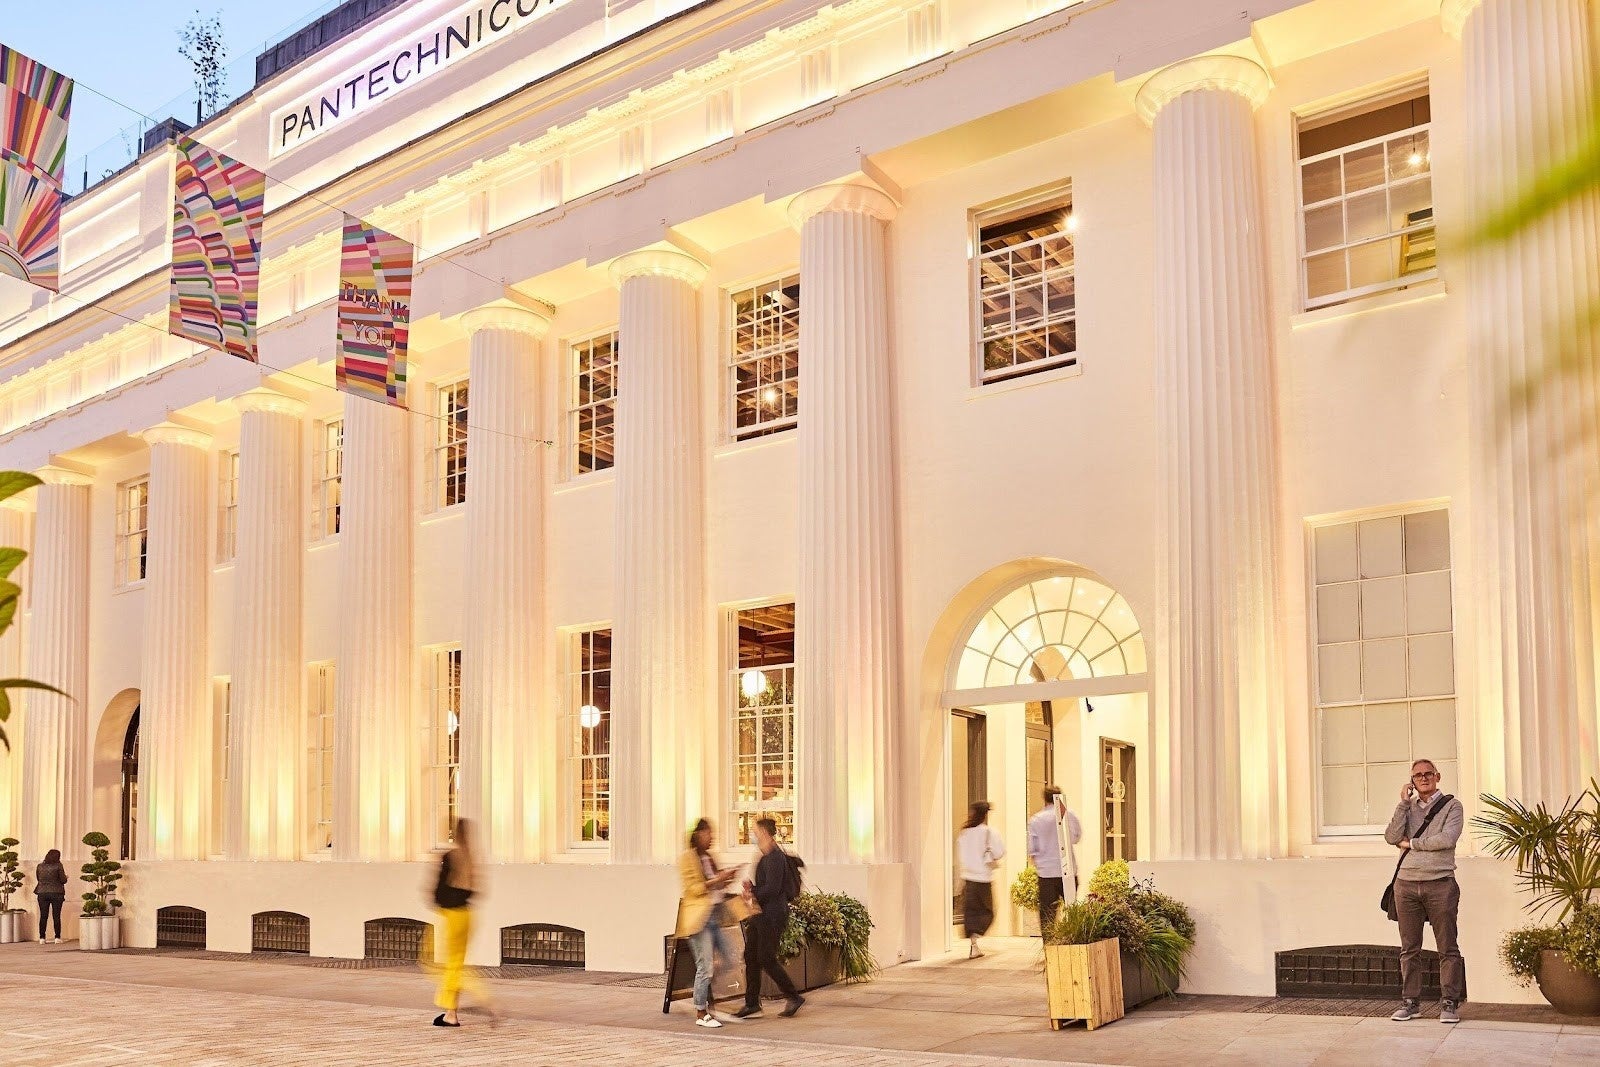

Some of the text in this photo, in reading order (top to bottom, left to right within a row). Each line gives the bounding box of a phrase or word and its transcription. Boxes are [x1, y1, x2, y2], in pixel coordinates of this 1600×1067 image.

[282, 0, 553, 147] PANTECHNICO
[342, 280, 407, 323] THANK
[352, 320, 395, 350] YOU
